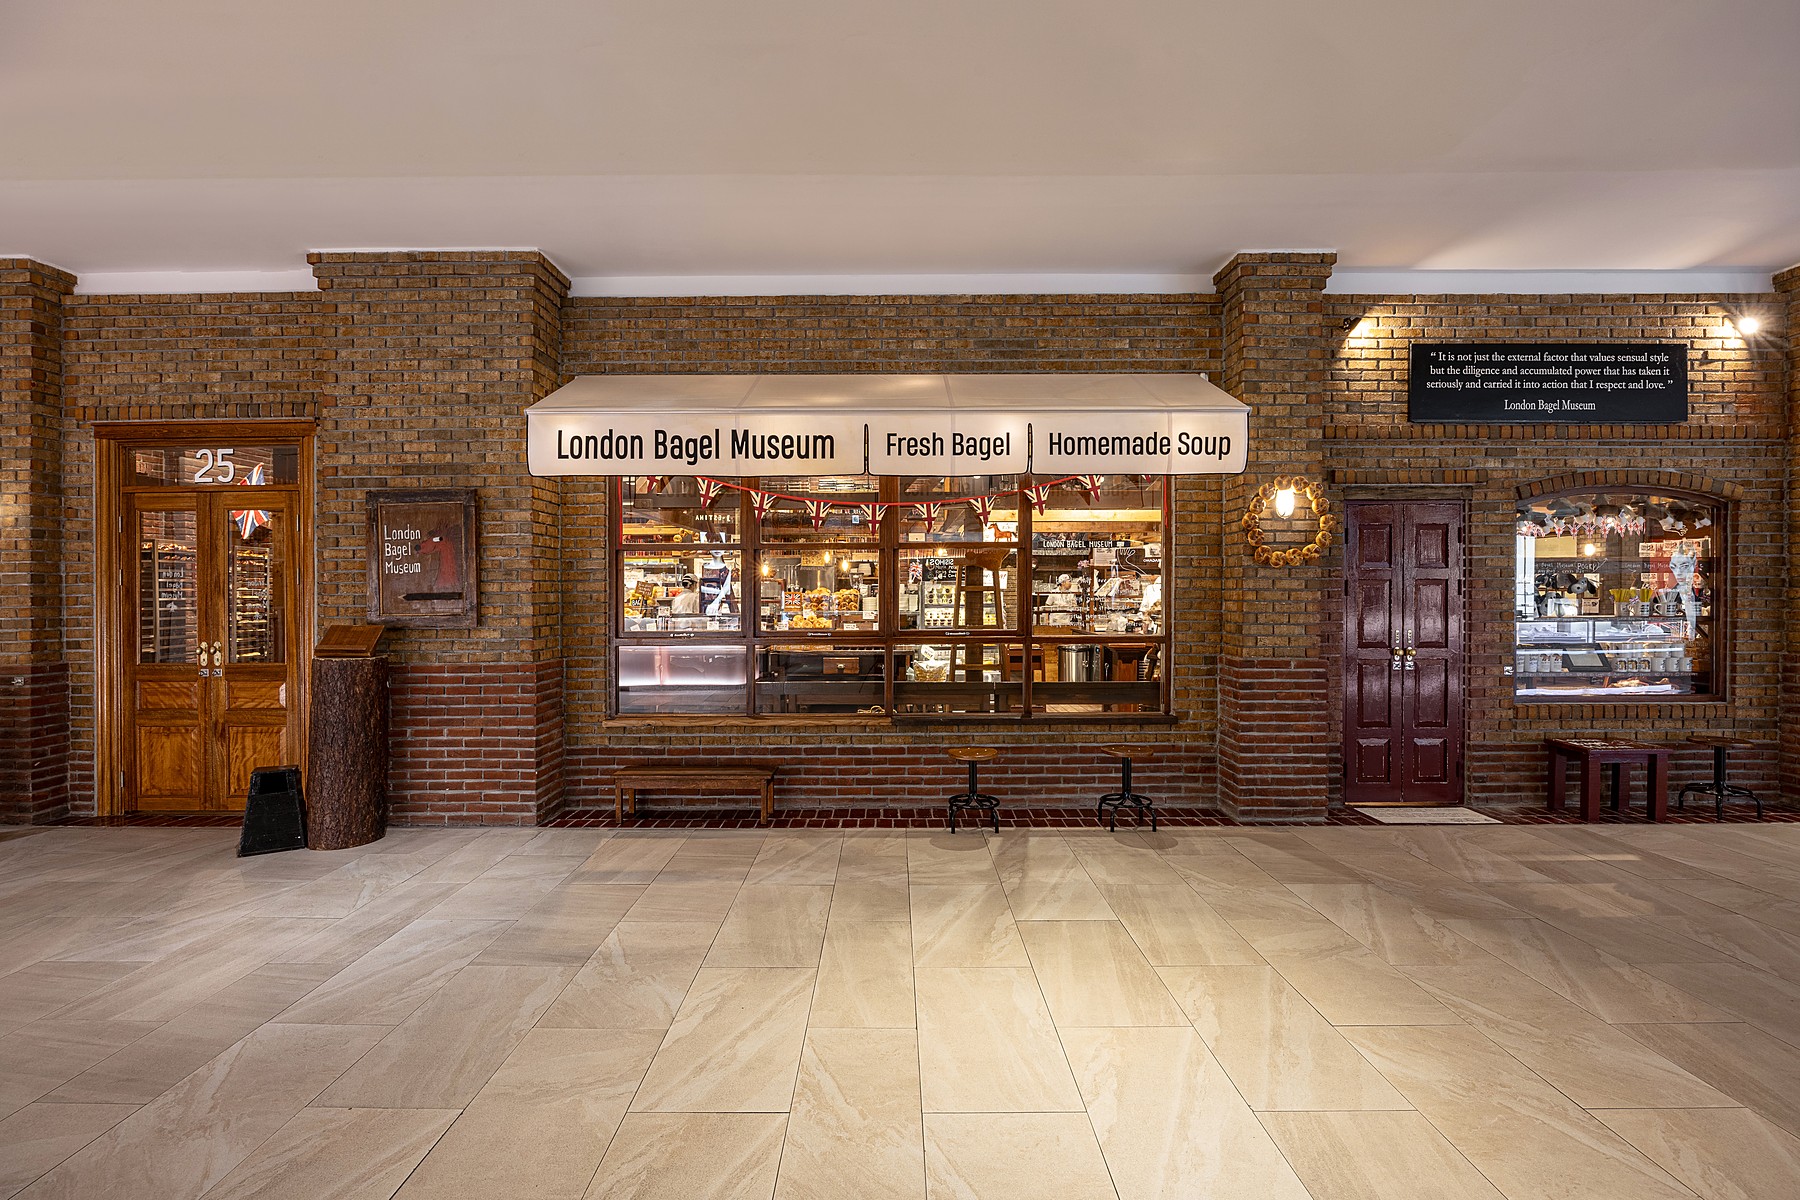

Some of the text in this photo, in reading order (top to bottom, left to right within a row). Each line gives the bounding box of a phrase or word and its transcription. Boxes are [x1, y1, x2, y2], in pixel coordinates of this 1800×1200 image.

[1448, 351, 1455, 361] is
[1457, 353, 1472, 361] not
[1473, 351, 1490, 364] just
[1491, 351, 1505, 361] the
[1507, 351, 1541, 361] external
[1543, 351, 1569, 361] factor
[1570, 352, 1588, 362] that
[1589, 352, 1616, 362] values
[1617, 352, 1648, 362] sensual
[1649, 352, 1669, 364] style
[1430, 365, 1670, 378] but the diligence and accumulated power that has taken it
[1426, 379, 1464, 391] seriously
[1465, 379, 1482, 389] and
[1483, 379, 1513, 389] carried
[1514, 379, 1522, 389] it
[1522, 379, 1541, 389] into
[1542, 379, 1569, 389] action
[1570, 379, 1588, 389] that
[1589, 380, 1594, 389] I
[1595, 380, 1627, 391] respect
[1627, 379, 1644, 389] and
[1504, 399, 1596, 413] London Bagel Museum
[557, 428, 835, 466] London Bagel Museum
[886, 432, 1010, 461] Fresh Bagel
[1049, 431, 1231, 461] Homemade Soup
[194, 448, 235, 483] 25
[384, 523, 421, 540] London
[384, 542, 412, 560] Bagel
[1043, 540, 1113, 548] LONDON BAGEL MUSEUM
[385, 561, 421, 574] Museum
